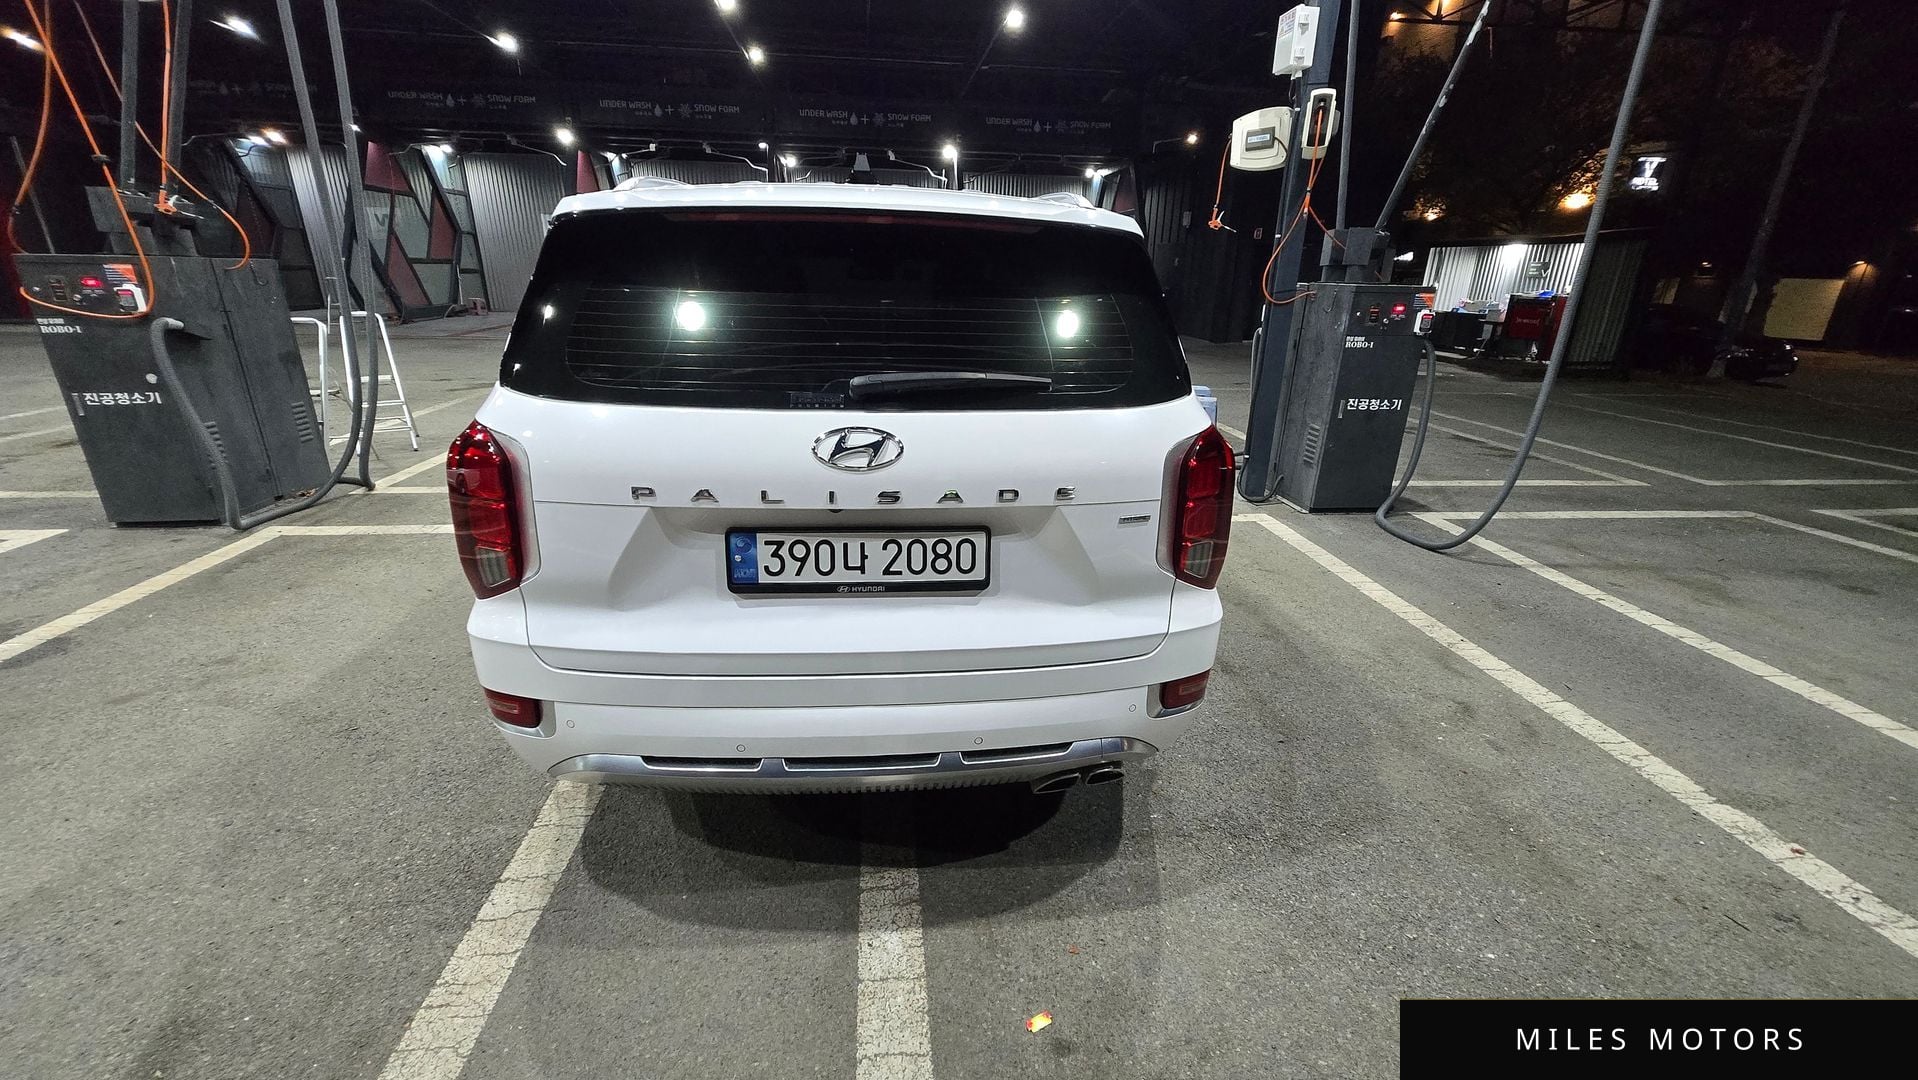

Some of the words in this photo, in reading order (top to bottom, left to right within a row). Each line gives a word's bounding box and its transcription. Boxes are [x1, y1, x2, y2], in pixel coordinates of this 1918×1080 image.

[82, 391, 162, 406] 진공청소기
[1347, 398, 1403, 411] 진공청소기
[631, 486, 1077, 504] PALISADE
[763, 539, 869, 577] 390나
[881, 537, 977, 576] 2080
